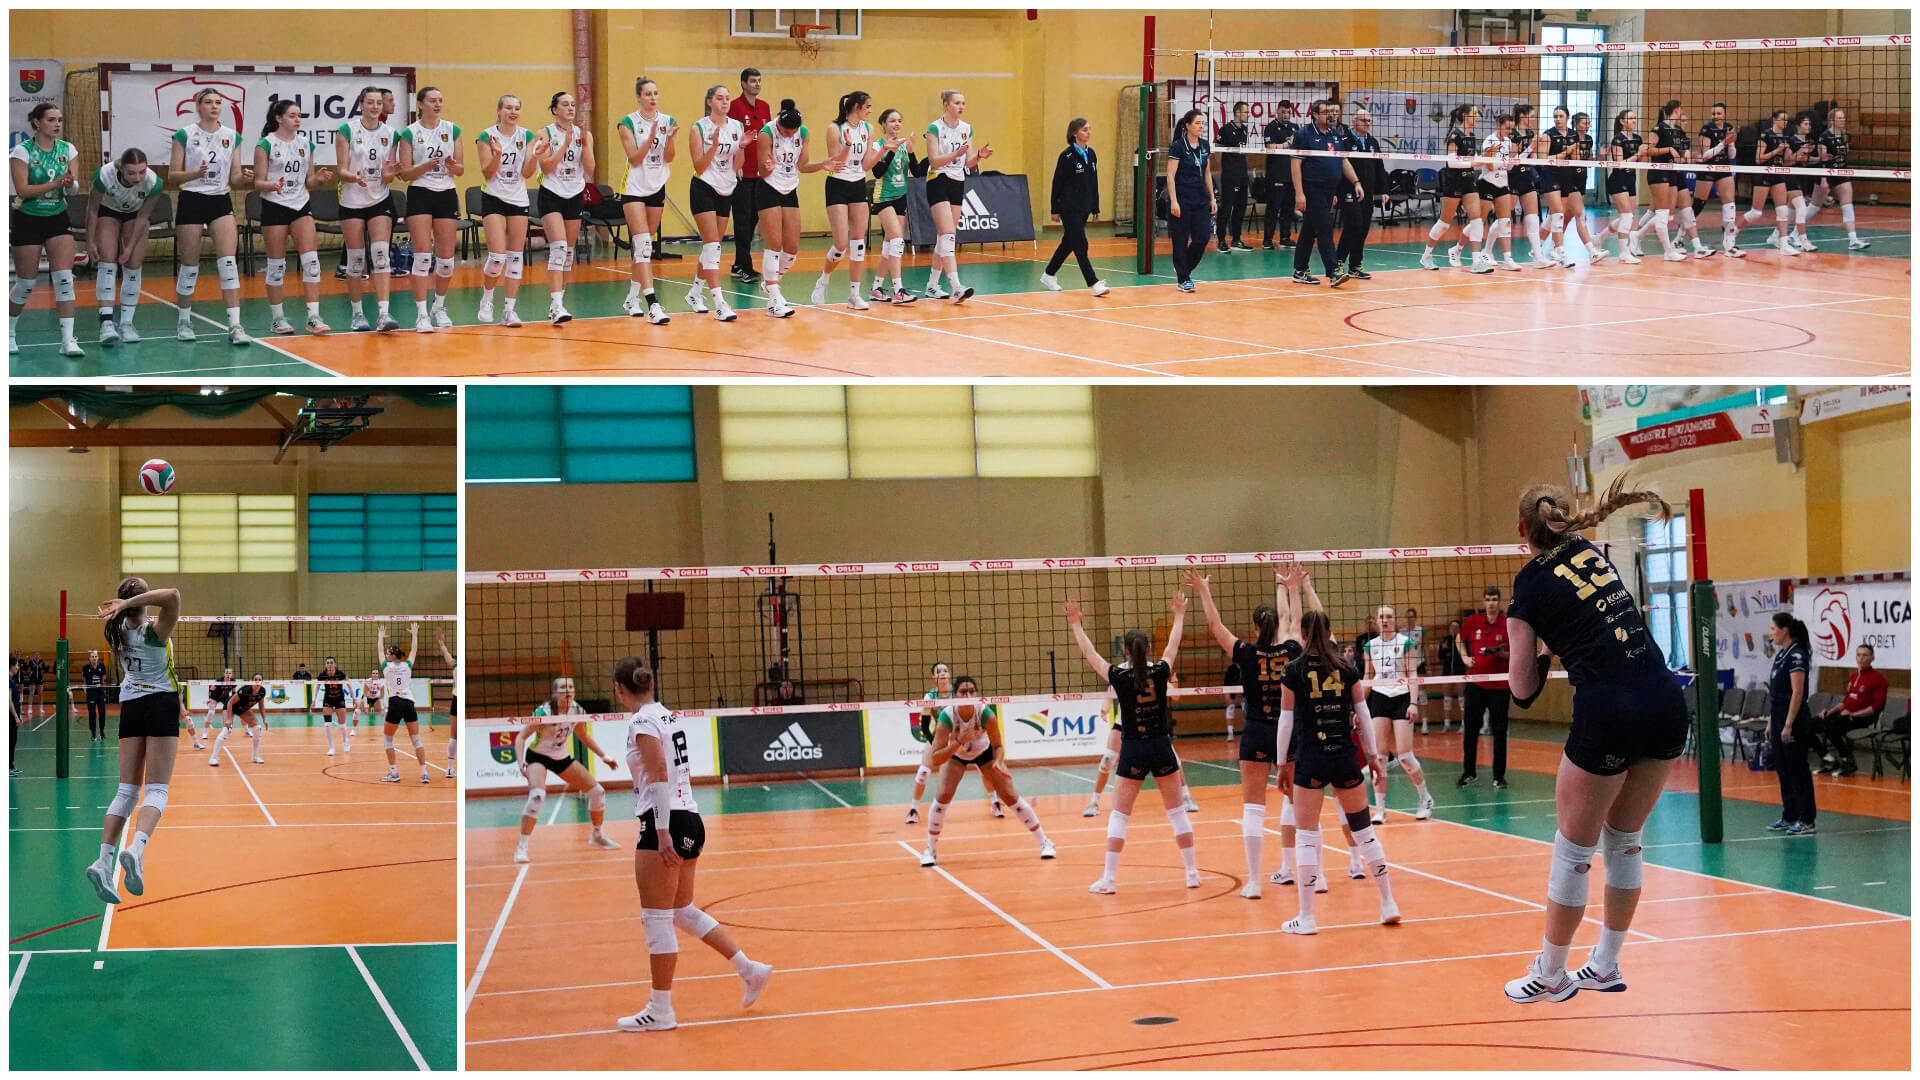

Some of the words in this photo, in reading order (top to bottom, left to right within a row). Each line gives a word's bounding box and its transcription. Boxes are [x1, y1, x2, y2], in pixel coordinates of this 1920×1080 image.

[1775, 39, 1796, 47] ORLEN
[1837, 37, 1860, 45] ORLEN
[426, 145, 443, 158] 26
[718, 143, 731, 154] 77
[852, 142, 863, 154] 10
[208, 151, 217, 163] 2
[369, 148, 377, 160] 8
[502, 152, 517, 165] 27
[563, 150, 575, 162] 18
[781, 152, 794, 163] 13
[284, 160, 300, 172] 60
[895, 158, 902, 170] 3
[48, 168, 56, 182] 9
[121, 201, 129, 209] 6
[1338, 550, 1362, 559] ORLEN
[1404, 549, 1427, 557] ORLEN
[1469, 546, 1491, 555] ORLEN
[1059, 558, 1085, 567] ORLEN
[1131, 556, 1156, 565] ORLEN
[1201, 555, 1226, 563] ORLEN
[1270, 553, 1294, 561] ORLEN
[836, 564, 863, 573] ORLEN
[912, 562, 939, 571] ORLEN
[986, 560, 1013, 569] ORLEN
[599, 570, 627, 579] ORLEN
[680, 568, 707, 577] ORLEN
[758, 566, 787, 575] ORLEN
[1553, 548, 1619, 600] 13
[516, 572, 546, 581] ORLEN
[1874, 600, 1911, 624] LIGA
[1862, 634, 1896, 648] KOBIET
[124, 656, 142, 672] 27
[396, 677, 402, 686] 8
[1307, 669, 1345, 699] 14
[1049, 714, 1098, 737] SMS
[555, 726, 570, 739] 27
[763, 745, 823, 762] adidas
